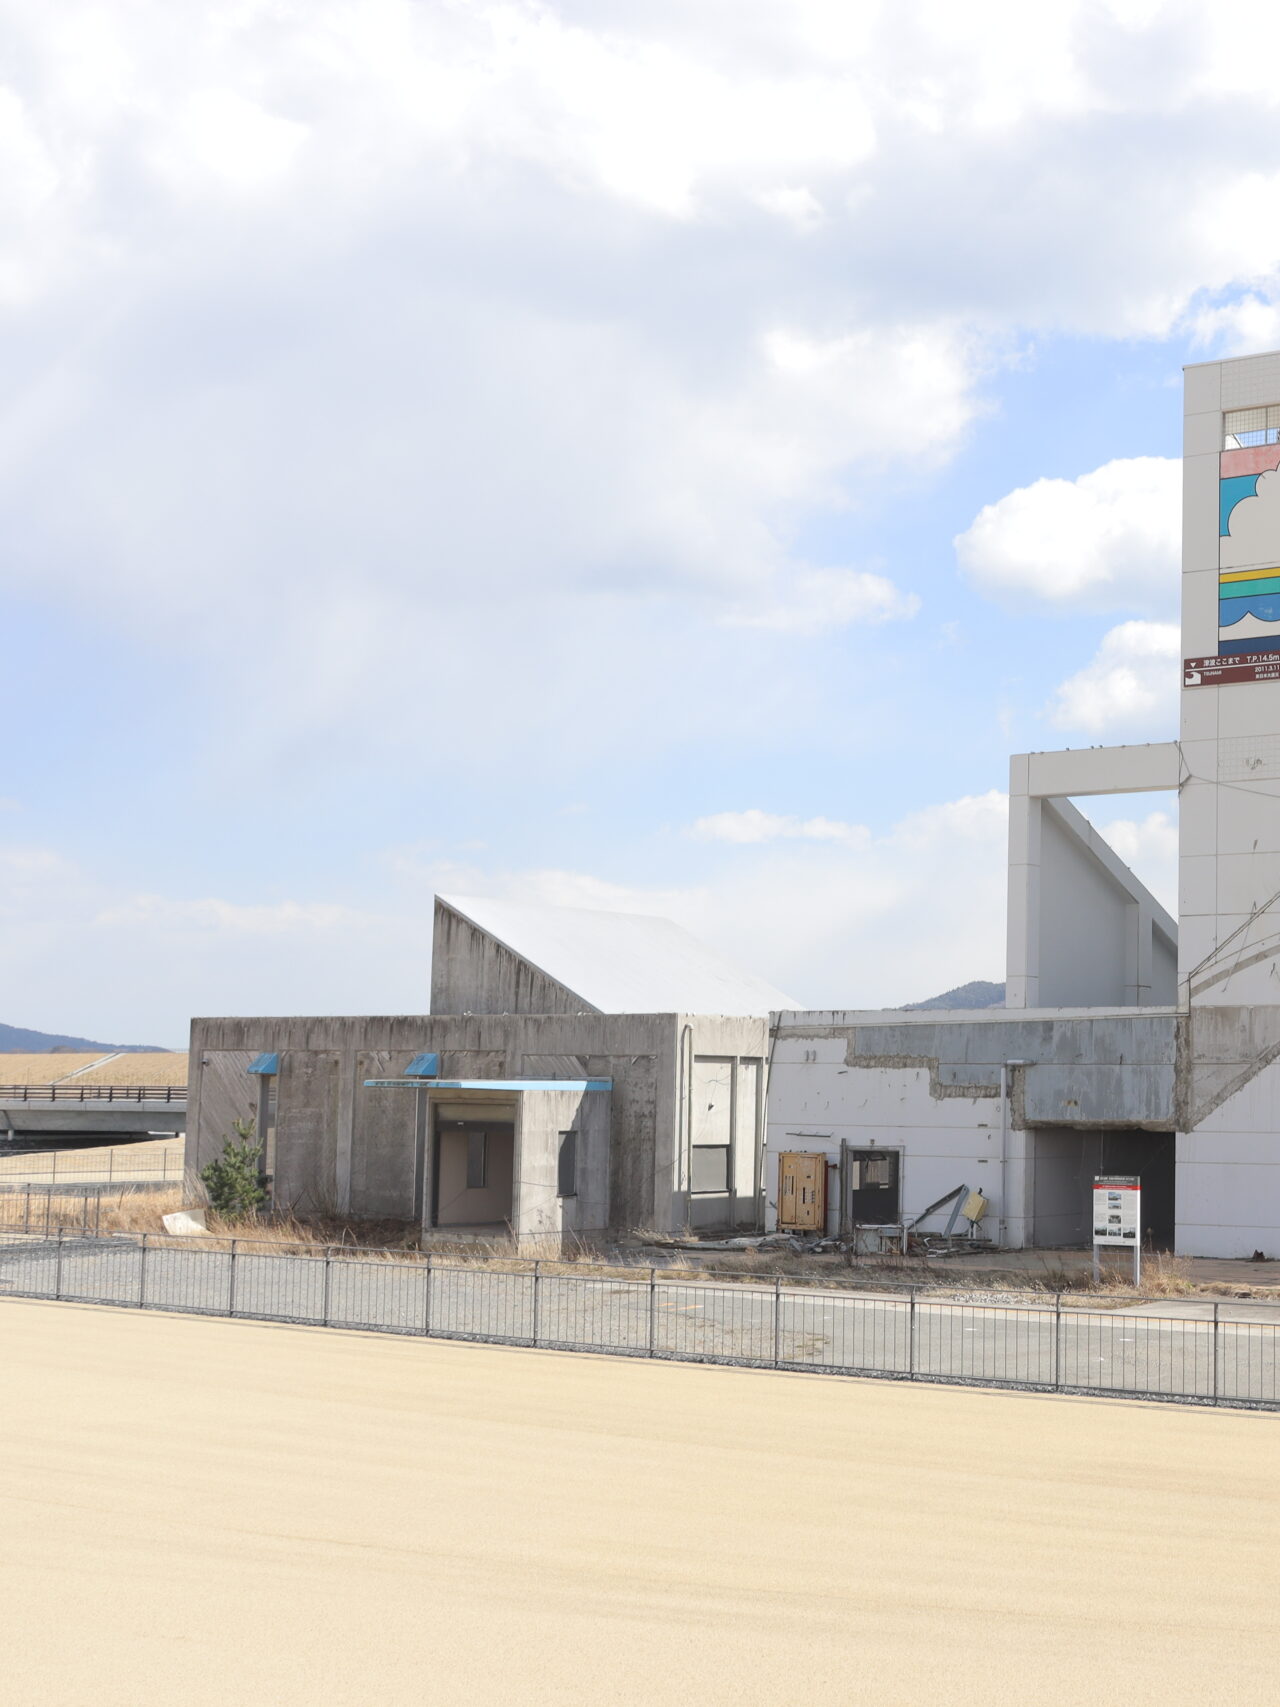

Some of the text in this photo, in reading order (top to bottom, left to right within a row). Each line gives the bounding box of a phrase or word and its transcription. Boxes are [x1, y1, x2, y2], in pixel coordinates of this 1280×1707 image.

[1203, 657, 1240, 667] 津波ここまで
